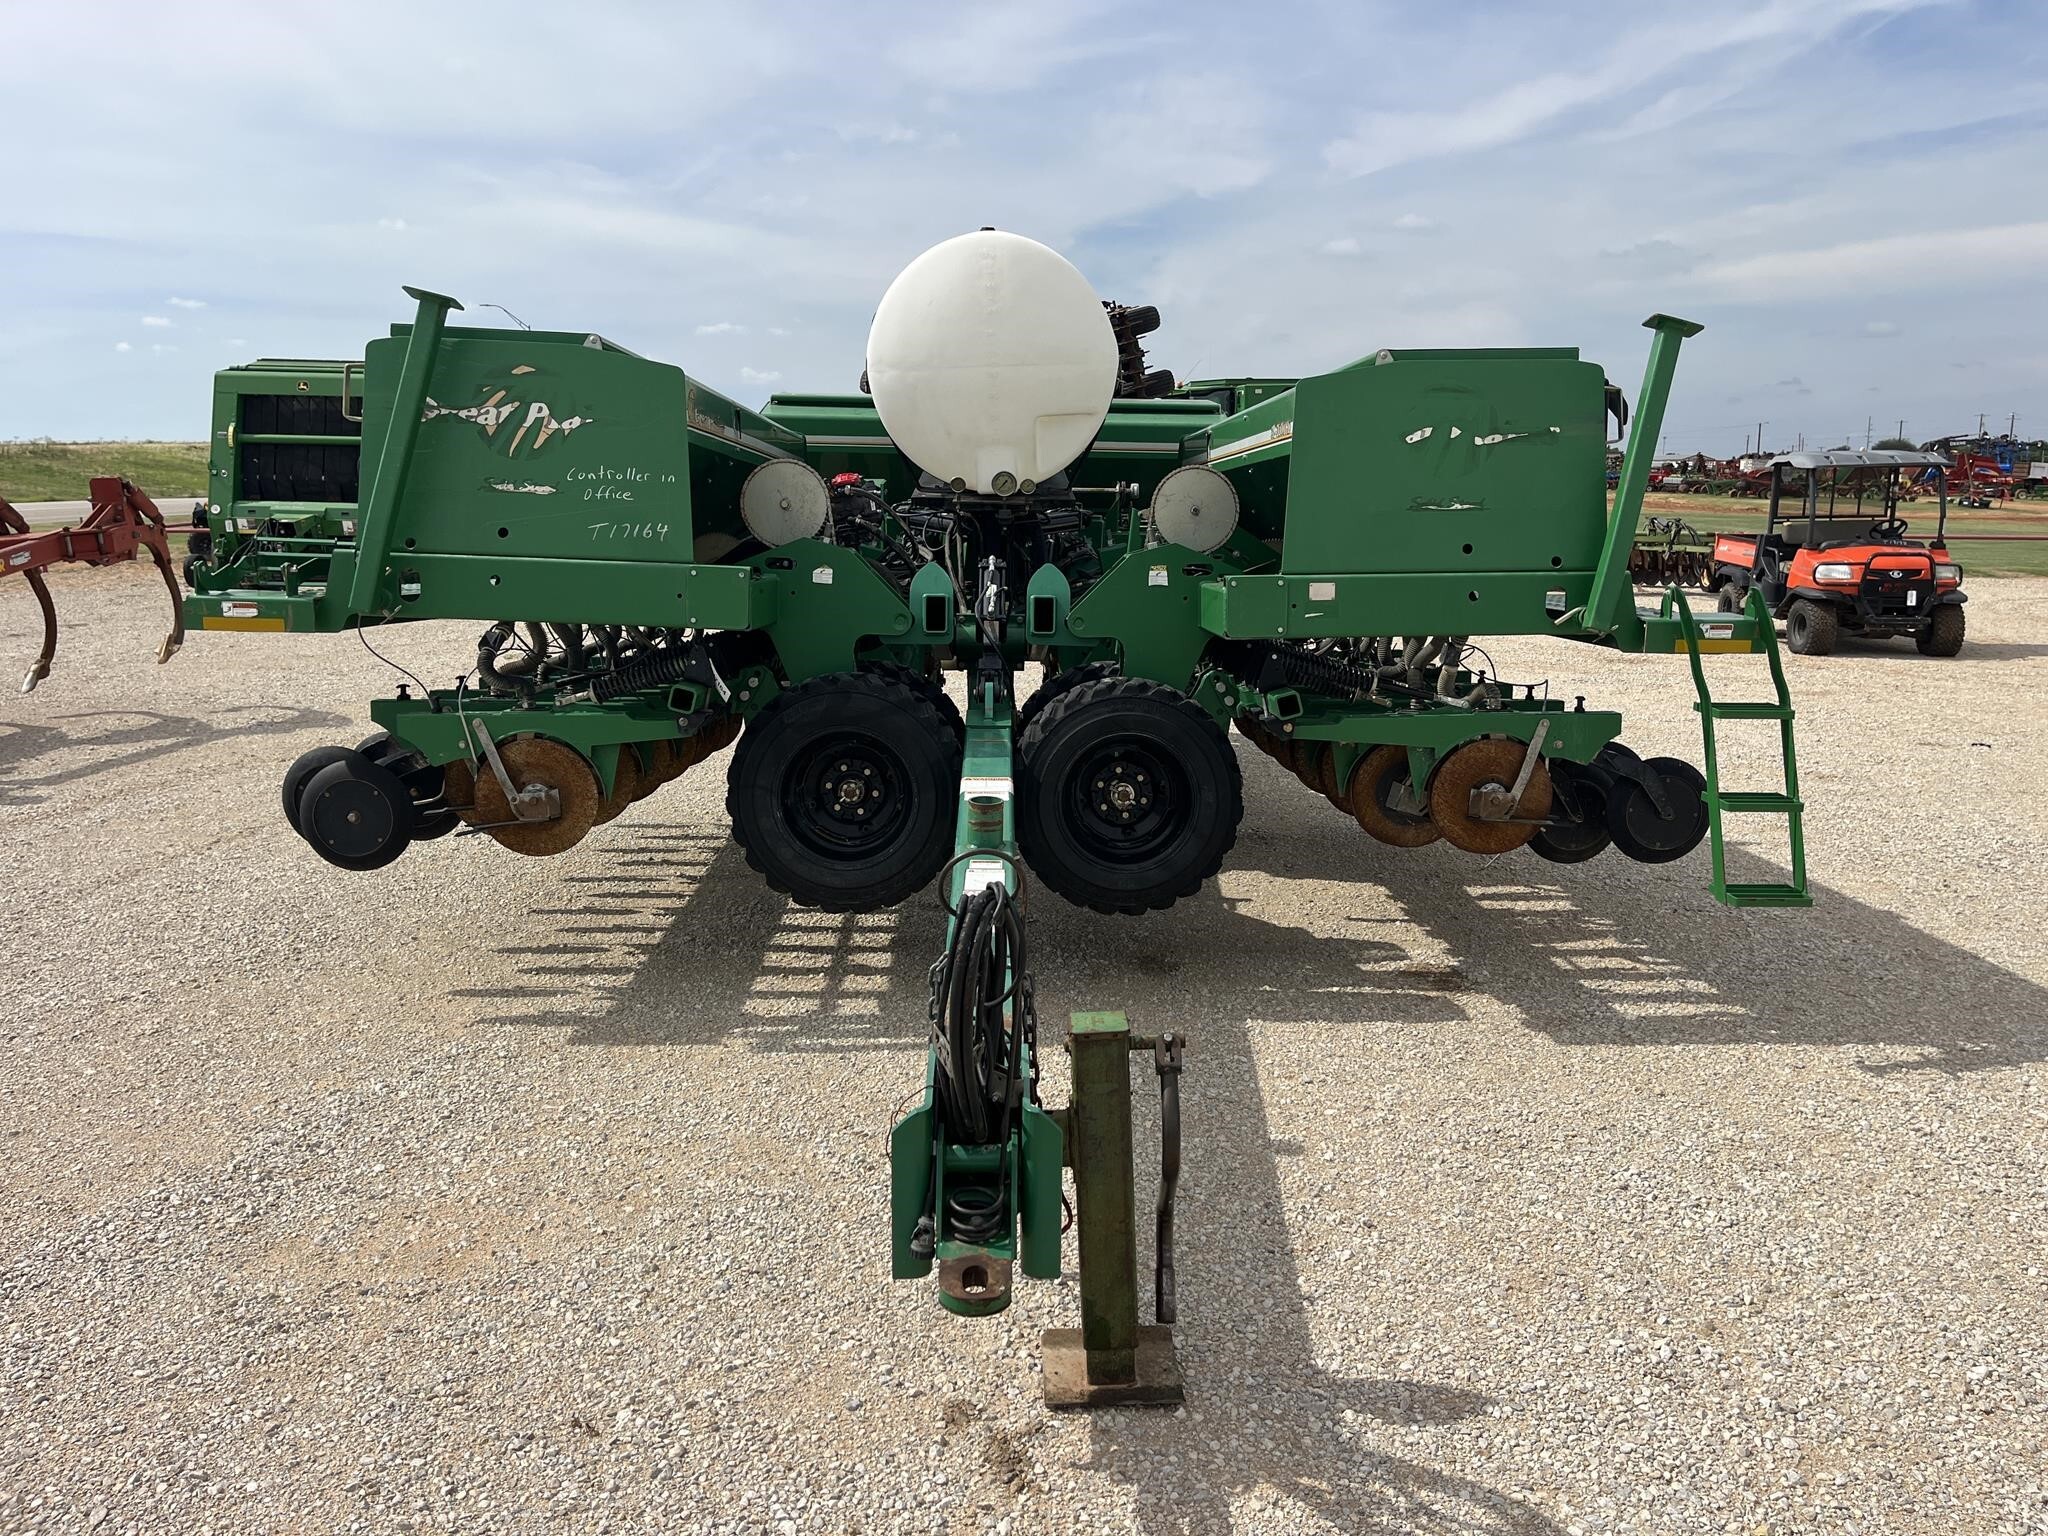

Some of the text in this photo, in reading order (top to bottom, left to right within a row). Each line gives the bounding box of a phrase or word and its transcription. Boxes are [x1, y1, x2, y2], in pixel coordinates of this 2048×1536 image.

[566, 465, 675, 483] Controller in
[587, 522, 669, 542] T17164
